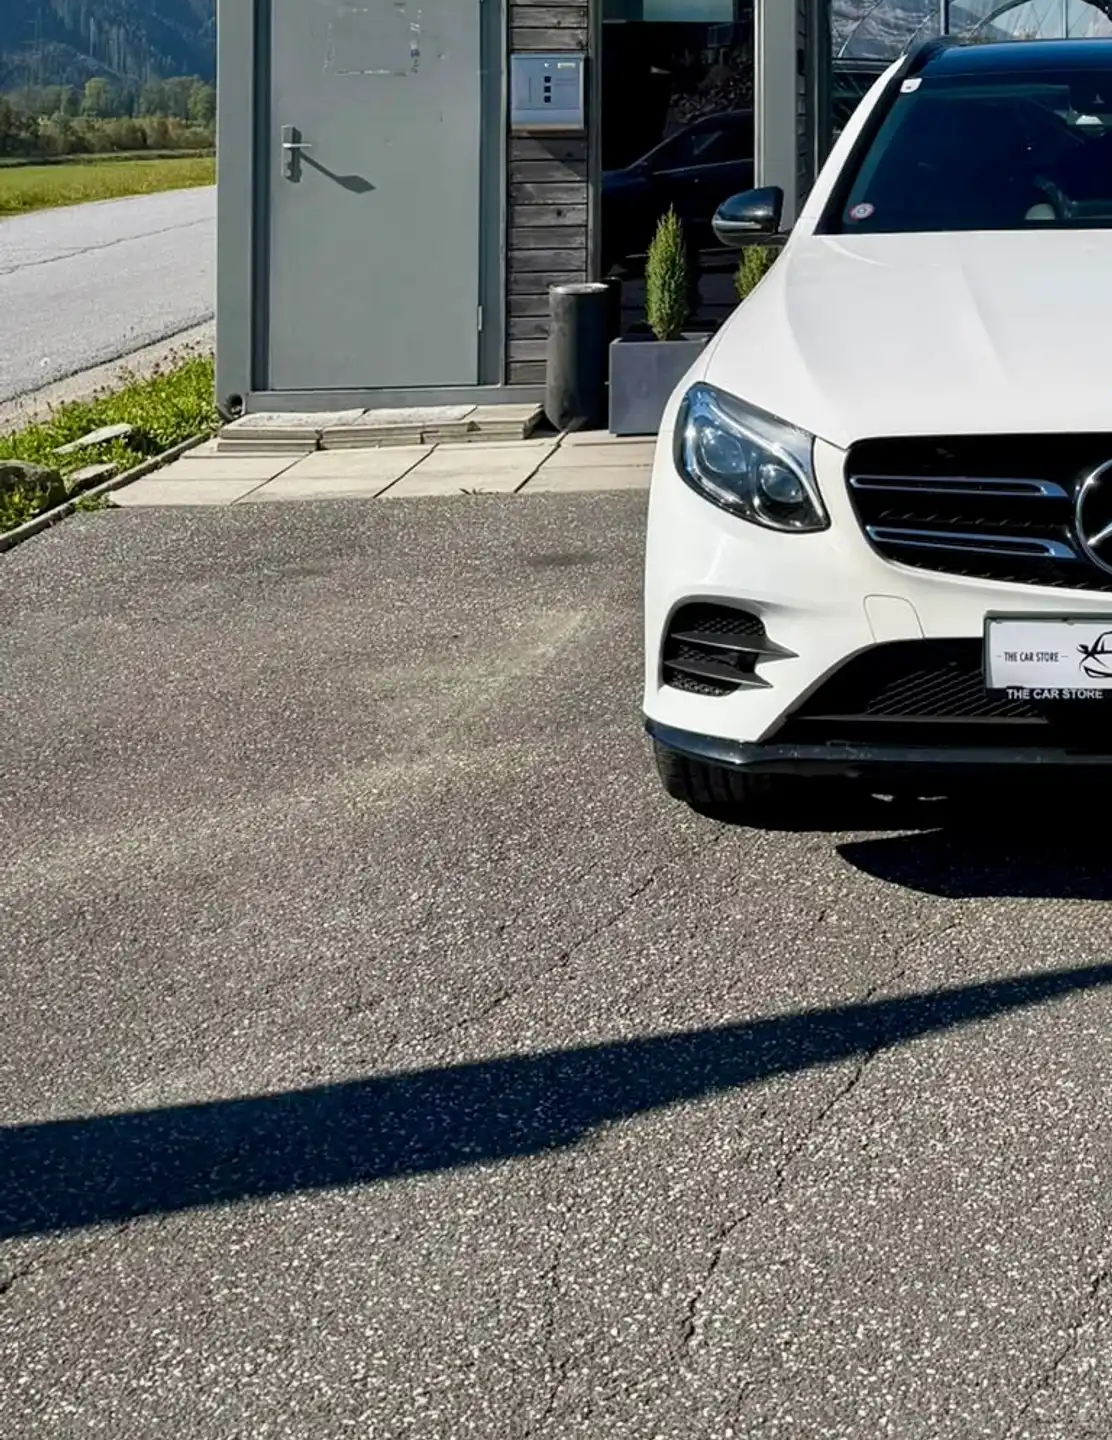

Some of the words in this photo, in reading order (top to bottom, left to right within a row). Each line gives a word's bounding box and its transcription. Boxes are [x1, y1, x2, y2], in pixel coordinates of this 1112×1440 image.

[1004, 651, 1018, 662] THE
[1019, 651, 1034, 662] CAR
[1036, 651, 1060, 662] STORE
[1006, 688, 1031, 700] THE
[1033, 688, 1060, 700] CAR
[1061, 688, 1104, 700] STORE
